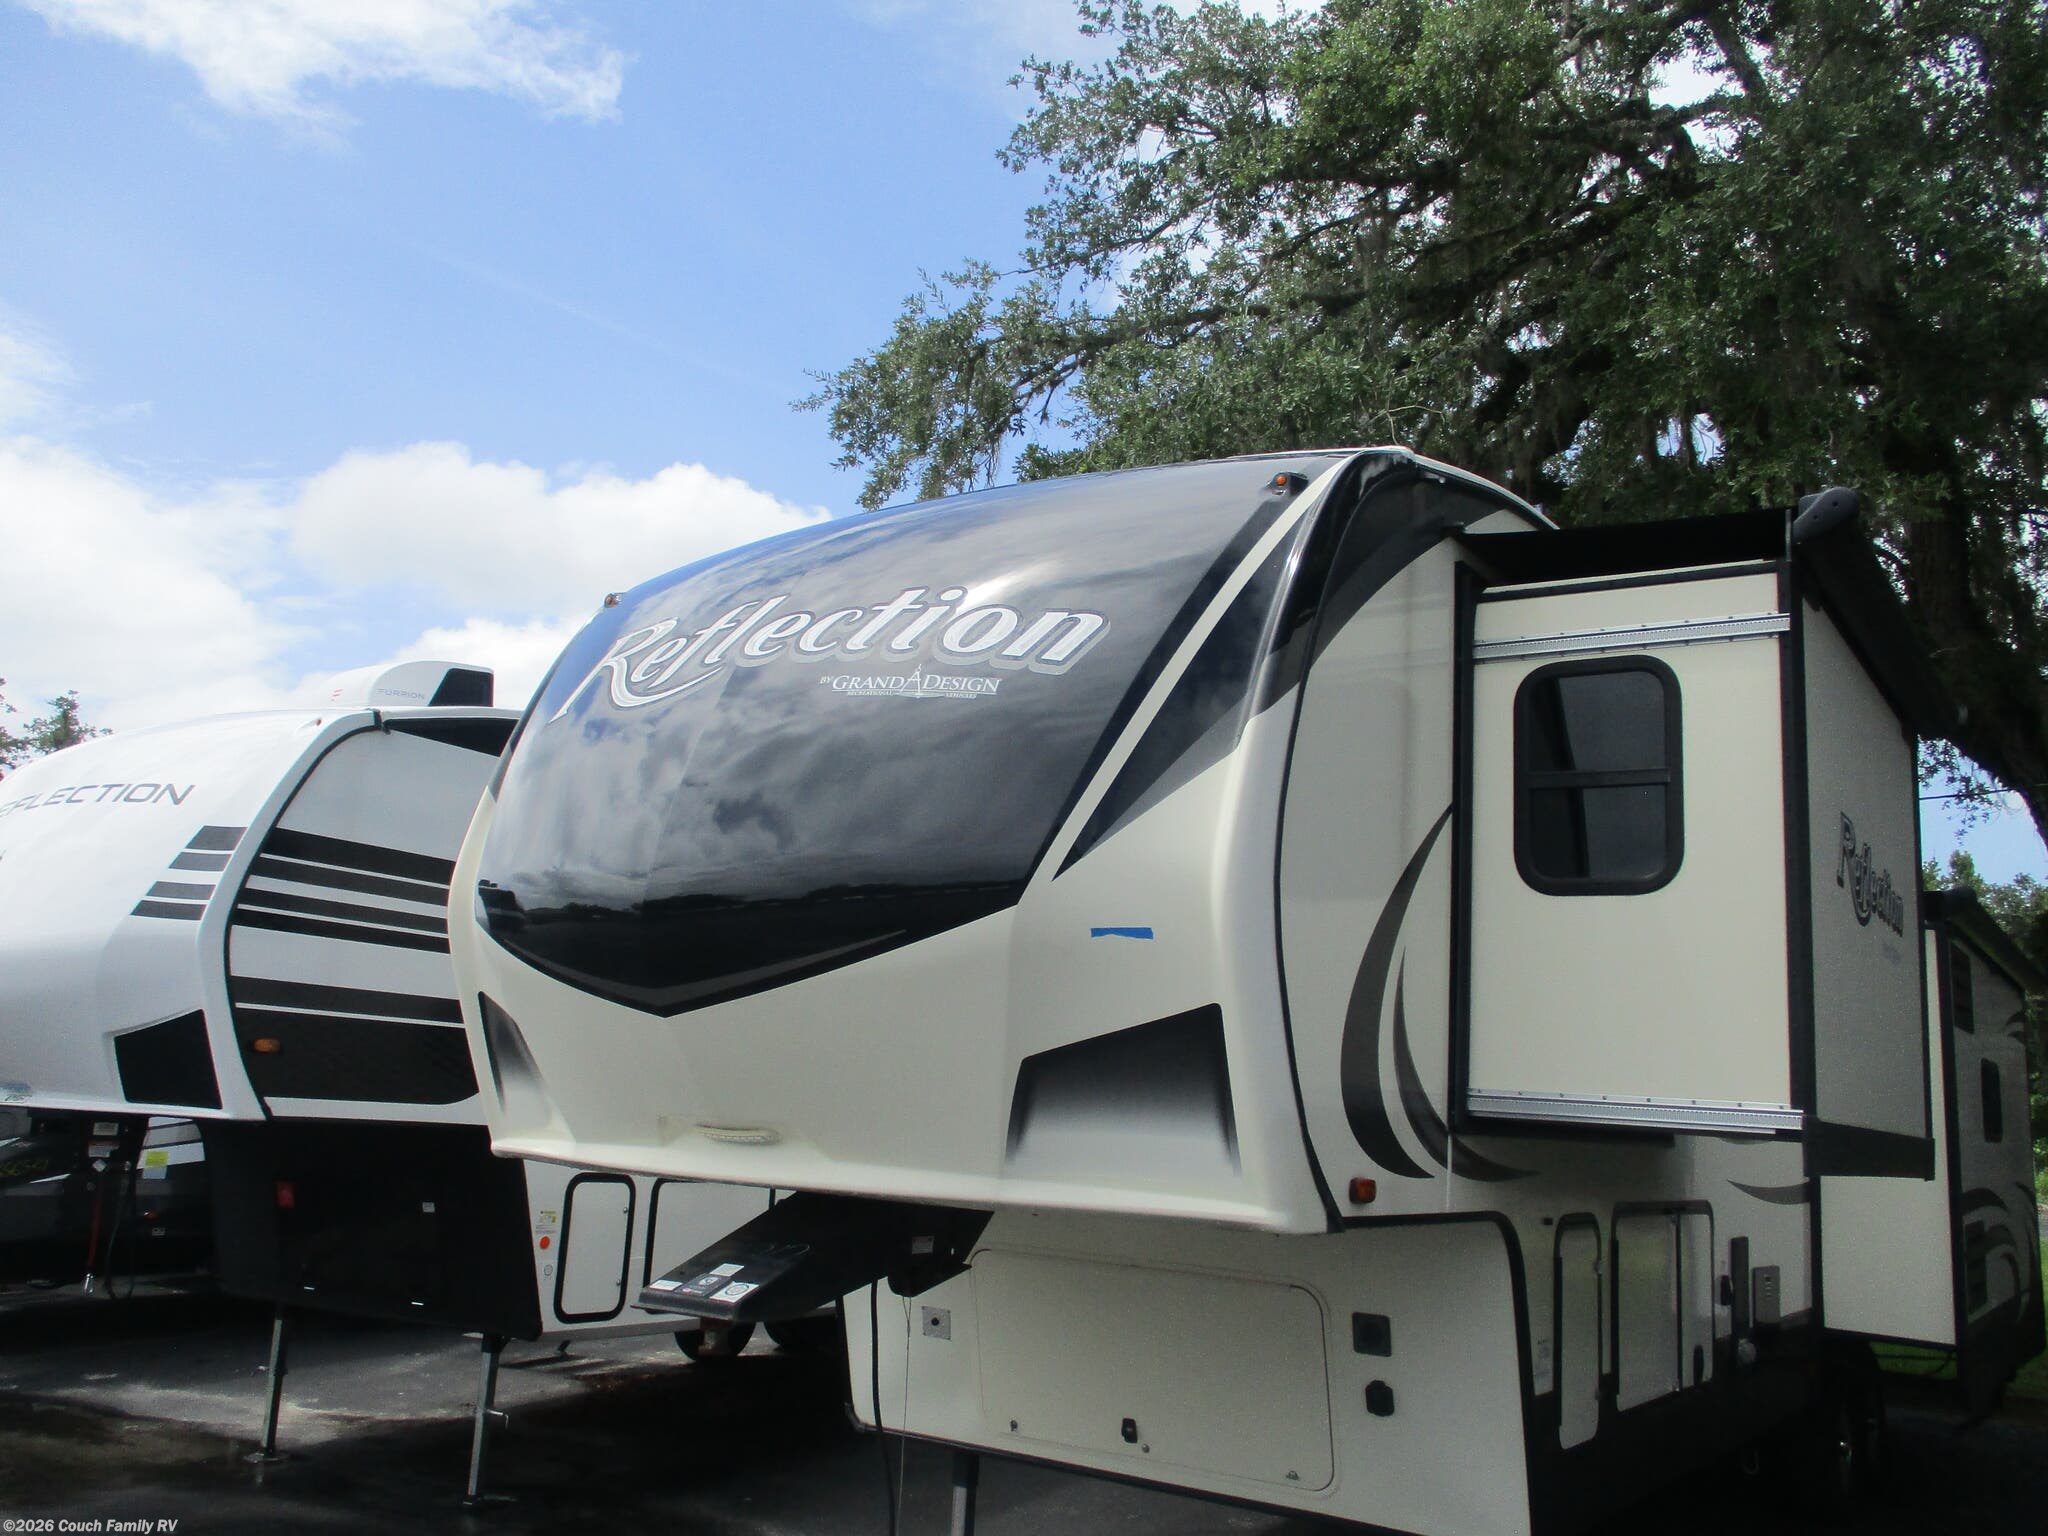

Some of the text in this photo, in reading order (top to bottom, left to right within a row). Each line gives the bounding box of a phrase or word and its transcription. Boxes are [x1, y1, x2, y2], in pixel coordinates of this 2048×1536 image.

[547, 585, 1111, 725] Reflection
[819, 674, 1001, 692] BY GRAND DESIGN
